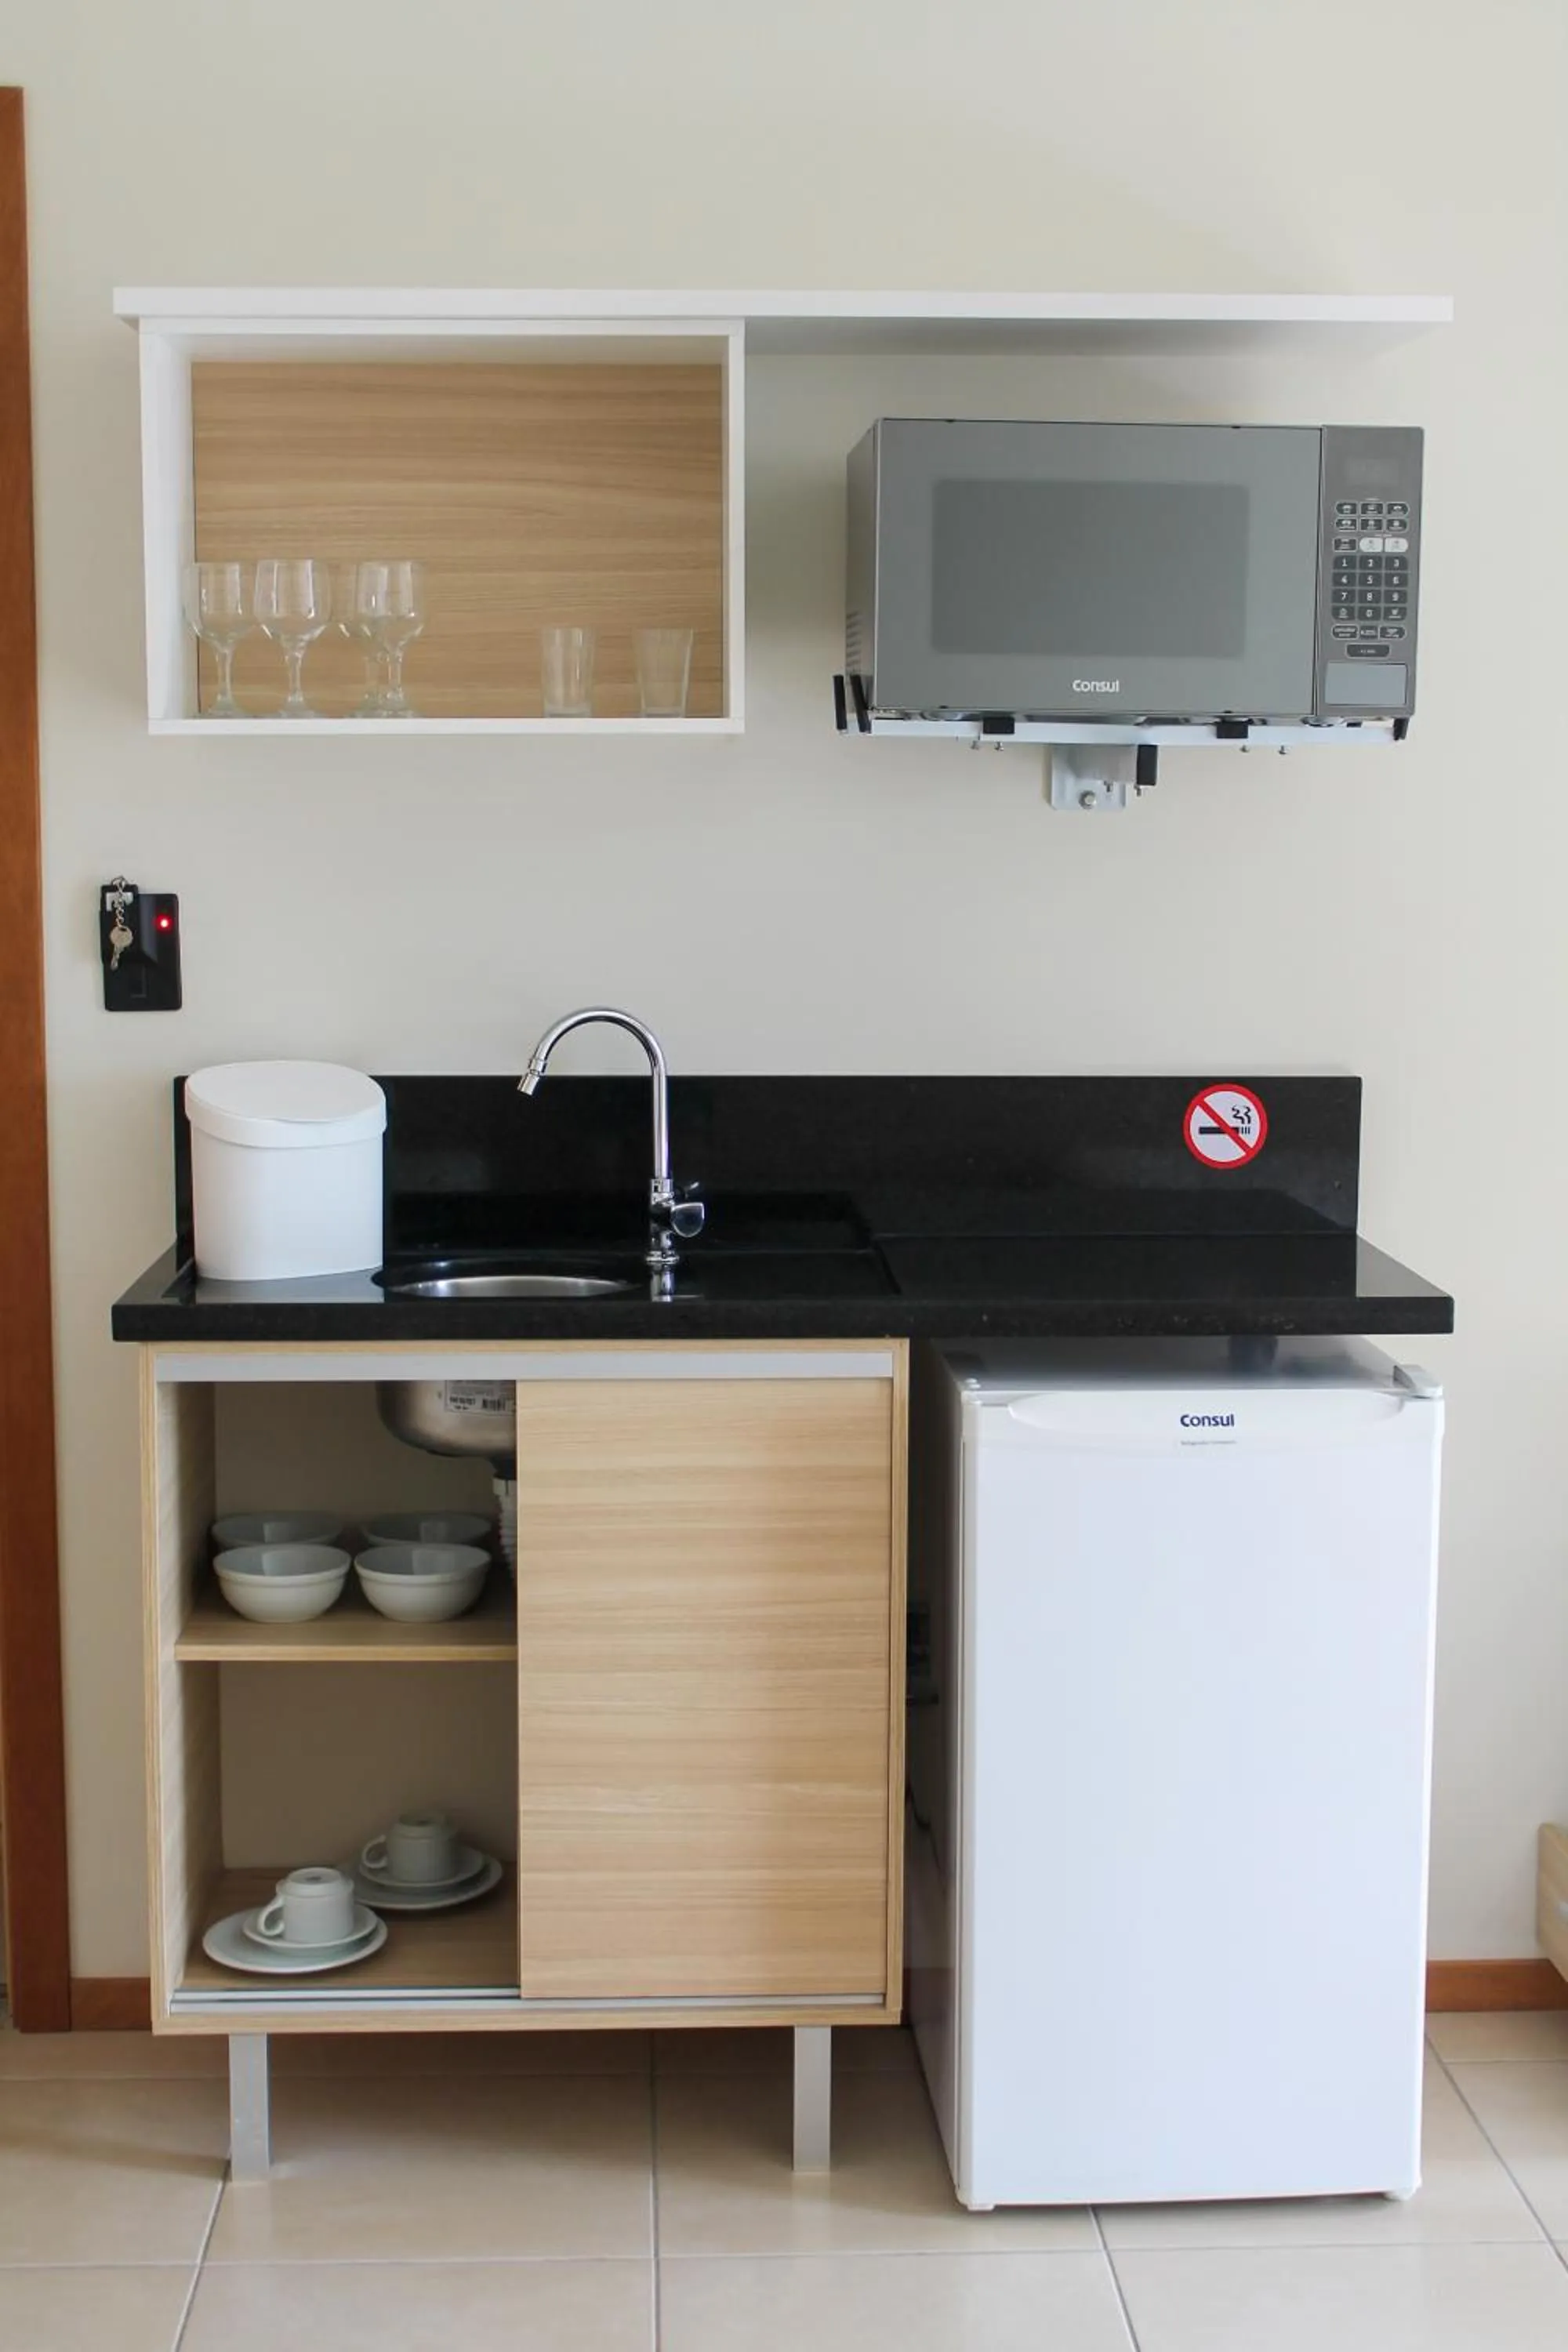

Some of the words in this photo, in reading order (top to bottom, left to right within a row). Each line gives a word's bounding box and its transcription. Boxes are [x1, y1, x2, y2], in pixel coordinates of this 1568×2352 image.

[1341, 557, 1348, 567] 1
[1393, 558, 1399, 568] 3
[1341, 575, 1348, 584] 4
[1367, 575, 1374, 584] 5
[1341, 591, 1348, 601] 7
[1367, 592, 1373, 601] 8
[1366, 608, 1374, 618] 0
[1072, 679, 1120, 693] Consul
[1179, 1414, 1235, 1428] Consul
